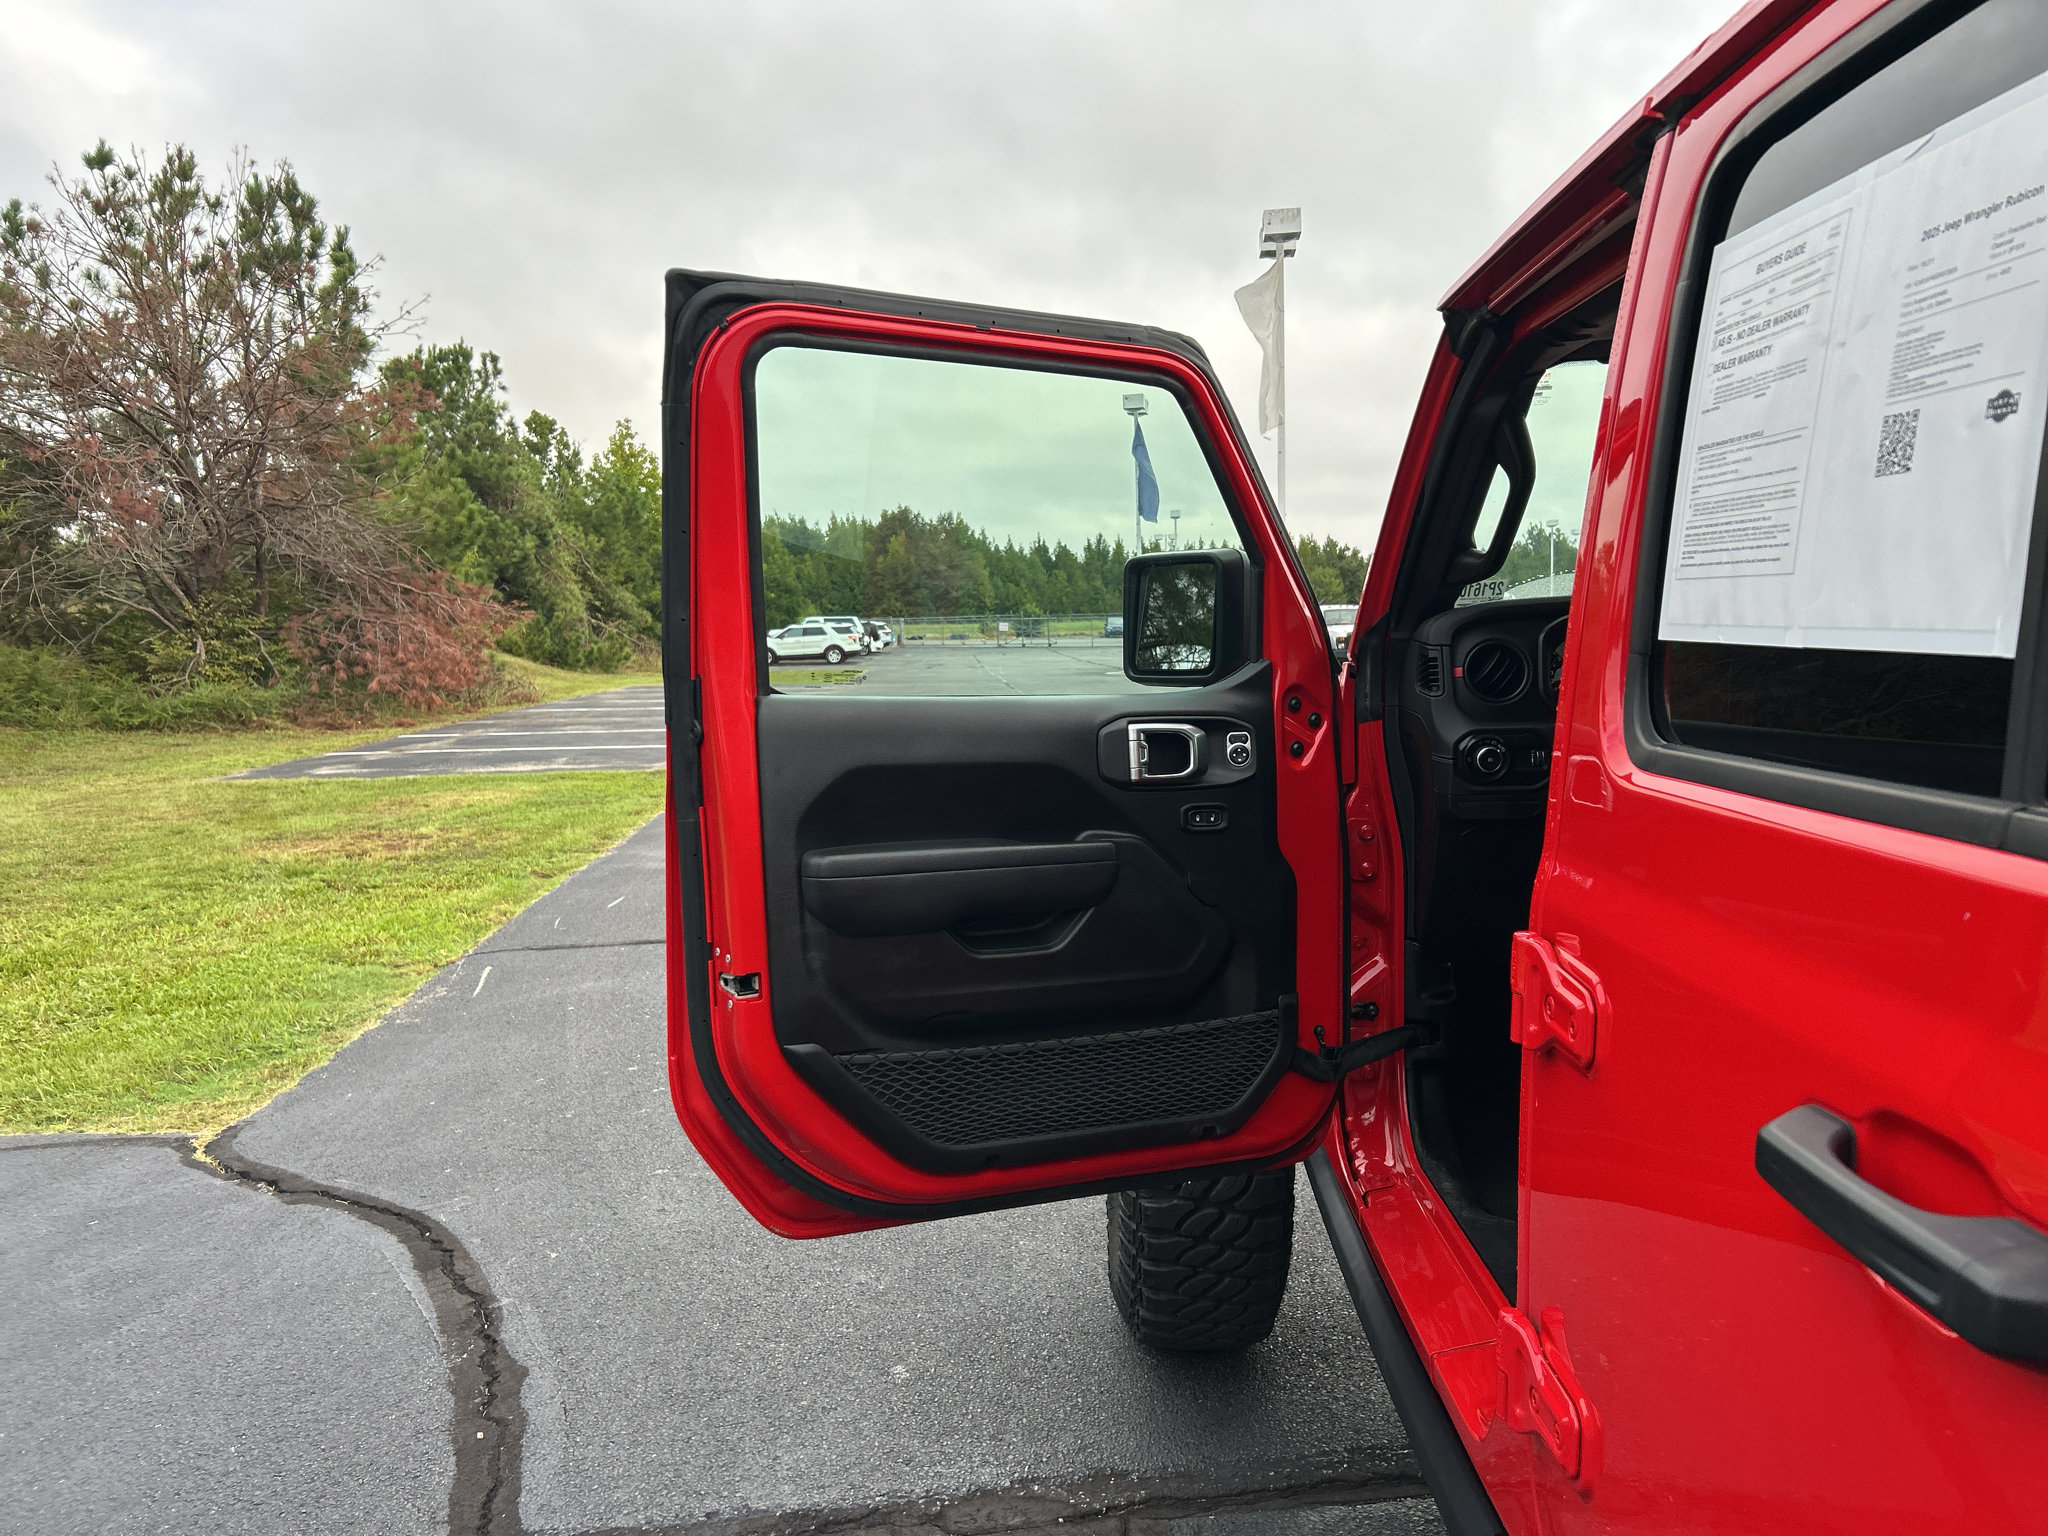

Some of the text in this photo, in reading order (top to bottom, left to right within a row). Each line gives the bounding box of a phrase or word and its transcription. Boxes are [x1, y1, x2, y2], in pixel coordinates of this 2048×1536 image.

[1942, 218, 1962, 234] Jeep
[1964, 202, 2003, 224] Wrangler
[2005, 184, 2045, 208] Rubicon
[1756, 242, 1807, 275] BUYERS GUIDE
[1717, 334, 1726, 348] AS
[1737, 328, 1747, 341] NO
[1746, 317, 1772, 336] DEALER
[1772, 303, 1811, 327] WARRANTY
[1713, 344, 1773, 374] DEALER WARRANTY
